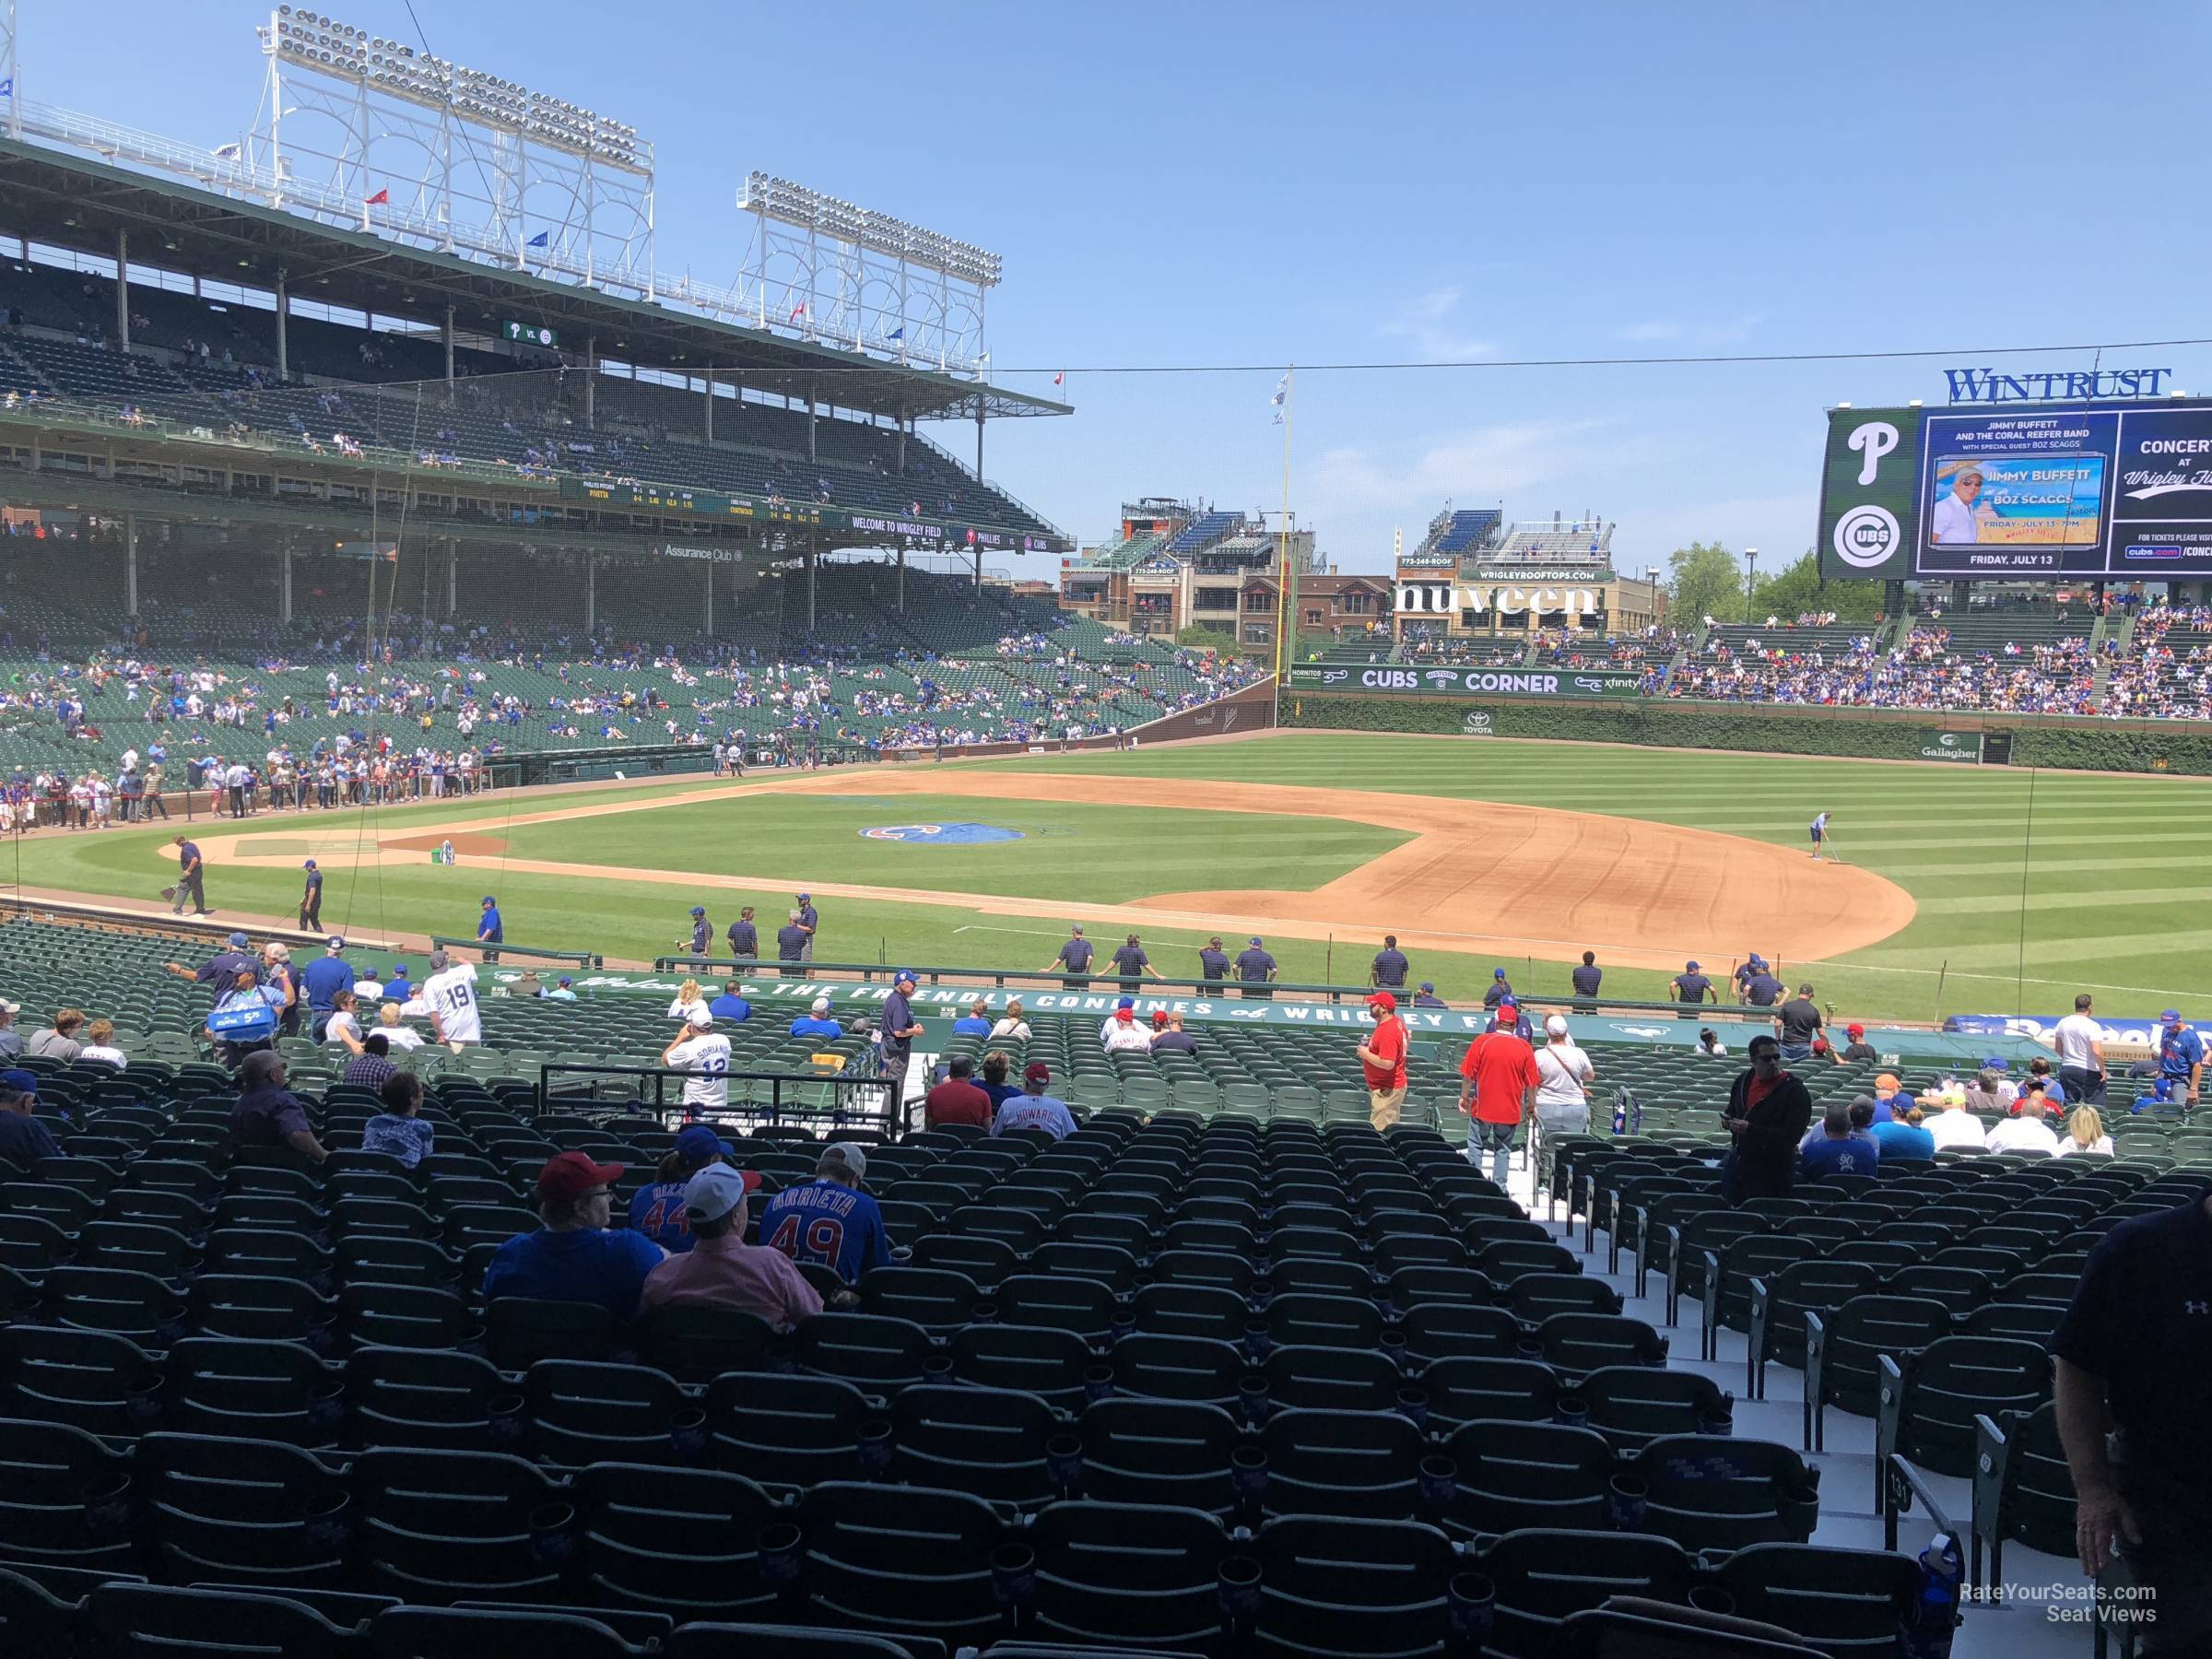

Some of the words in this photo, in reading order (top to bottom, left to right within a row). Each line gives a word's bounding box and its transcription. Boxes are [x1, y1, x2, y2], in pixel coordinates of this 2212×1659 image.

[1943, 368, 2172, 402] WINTRUST
[1987, 421, 2017, 430] JIMMY
[2018, 419, 2058, 429] BUFFETT
[1955, 432, 1975, 441] AND
[1976, 432, 1994, 441] THE
[1994, 431, 2025, 440] CORAL
[2027, 429, 2063, 439] REEFER
[2064, 429, 2089, 438] BAND
[2032, 441, 2048, 449] BOZ
[2049, 440, 2080, 448] SCAGGS
[1848, 421, 1899, 486] P
[2177, 458, 2192, 466] AT
[1987, 470, 2028, 482] JIMMY
[2031, 469, 2090, 482] BUFFETT
[2124, 470, 2187, 488] Wrigley
[1994, 495, 2018, 505] BOZ
[2021, 494, 2074, 505] SCAGGS
[853, 516, 886, 531] WELCOME
[887, 520, 896, 532] TO
[897, 522, 924, 535] WRIGLEY
[924, 524, 942, 537] FIELD
[2021, 520, 2043, 528] JULY
[977, 532, 1001, 546] PHILLIES
[1033, 538, 1047, 550] CUBS
[2138, 534, 2150, 542] FOR
[2151, 534, 2175, 542] TICKETS
[665, 544, 712, 559] Assurance
[712, 548, 733, 561] Club
[1970, 555, 2009, 566] FRIDAY,
[2011, 555, 2038, 565] JULY
[2040, 555, 2053, 565] 13
[1480, 571, 1595, 581] WRIGLEYROOFTOPS.COM
[1394, 584, 1600, 616] nuveen
[1292, 669, 1322, 677] HORNITOS
[1361, 669, 1418, 688] CUBS
[1427, 671, 1458, 680] HISTORY
[1465, 673, 1559, 694] CORNER
[1605, 677, 1640, 690] xfinity
[1463, 725, 1493, 735] TOYOTA
[1921, 746, 1977, 759] Gallagher
[446, 983, 470, 1010] 19
[771, 983, 840, 998] THE
[849, 986, 1024, 1005] FRENDLY
[1283, 1006, 1442, 1027] WRIGEY
[1016, 1108, 1053, 1123] HOWARD
[653, 1182, 689, 1199] RIZZ
[771, 1187, 857, 1218] ARRIETA
[768, 1213, 844, 1270] 49
[1890, 1473, 1908, 1503] 131
